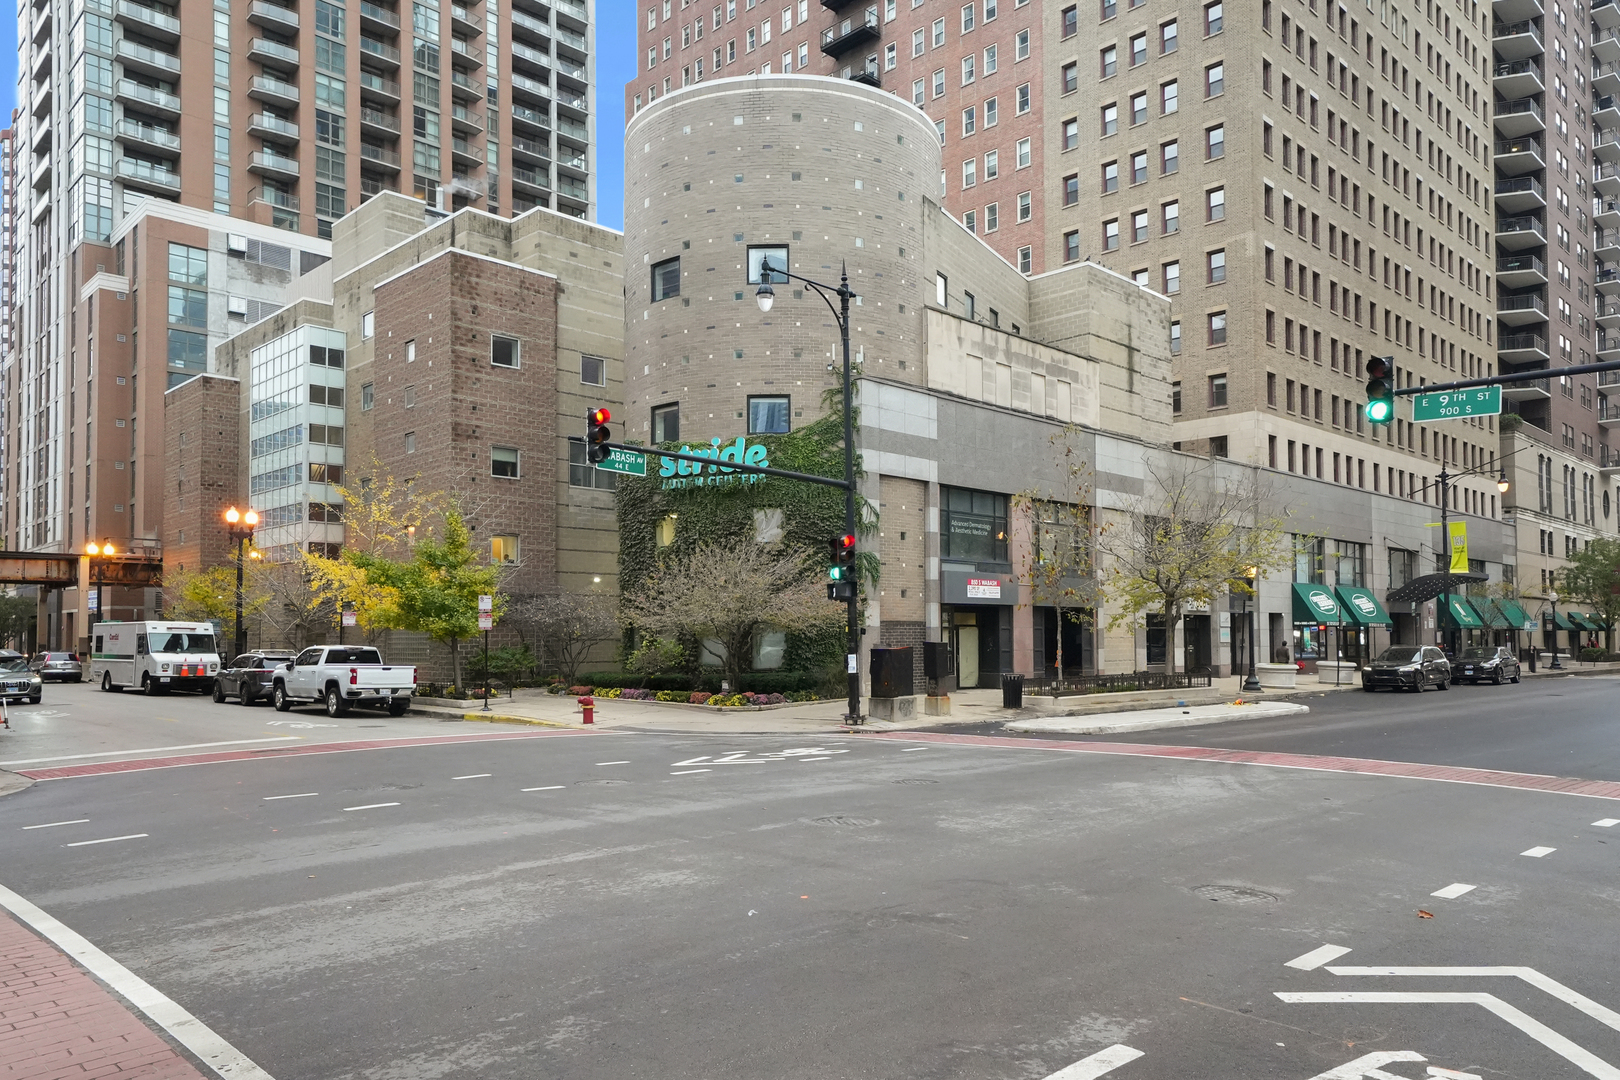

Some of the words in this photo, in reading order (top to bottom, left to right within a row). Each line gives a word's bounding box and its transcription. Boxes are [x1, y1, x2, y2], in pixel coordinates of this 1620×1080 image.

[1422, 398, 1429, 406] E
[1439, 393, 1466, 406] 9TH
[1477, 392, 1490, 400] ST
[1440, 406, 1459, 415] 900
[1466, 405, 1472, 413] S
[608, 451, 636, 464] ABASH
[659, 437, 769, 477] stride
[615, 462, 623, 470] 44
[625, 463, 629, 471] E
